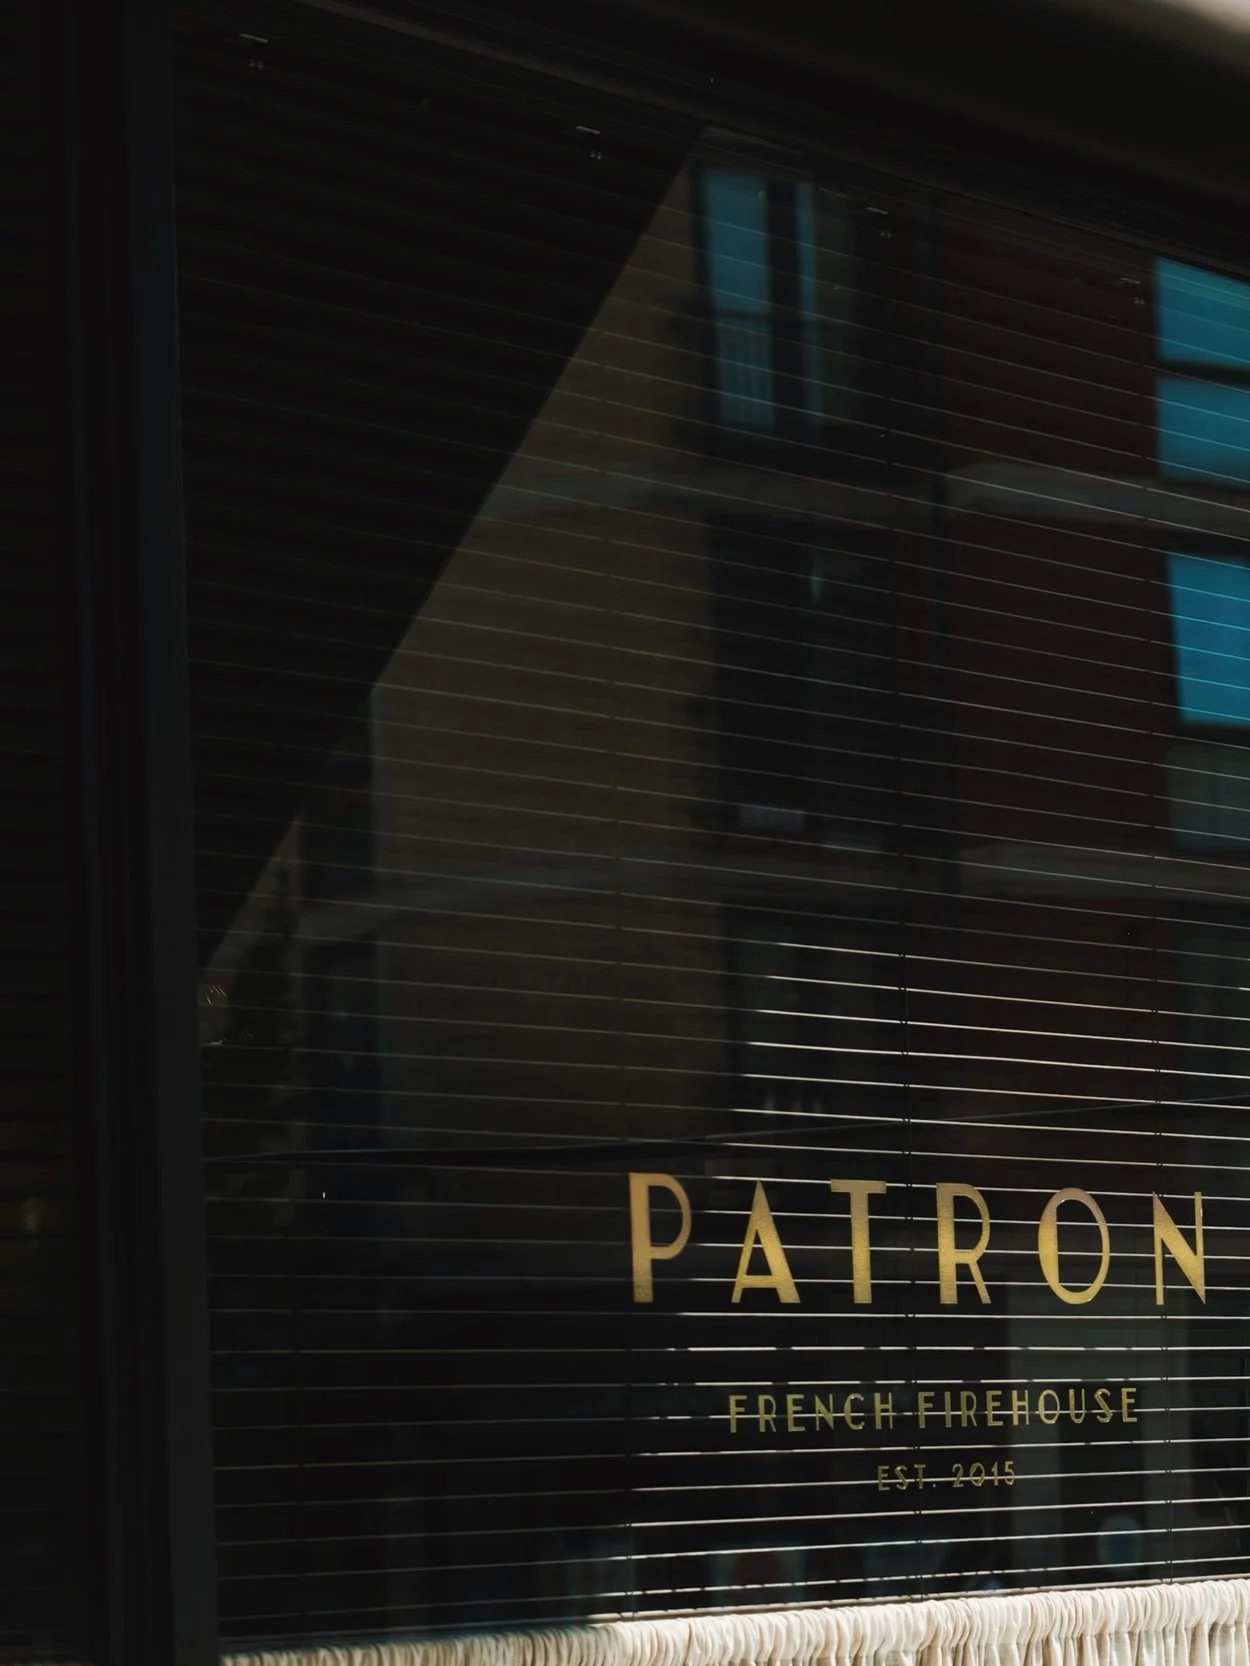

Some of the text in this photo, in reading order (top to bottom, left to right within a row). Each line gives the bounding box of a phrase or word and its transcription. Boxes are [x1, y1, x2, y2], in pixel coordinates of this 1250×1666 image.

[629, 1173, 1206, 1305] PATRON
[729, 1388, 1138, 1433] FRENCH FIREHOUSE
[877, 1461, 1017, 1491] EST. 2015
